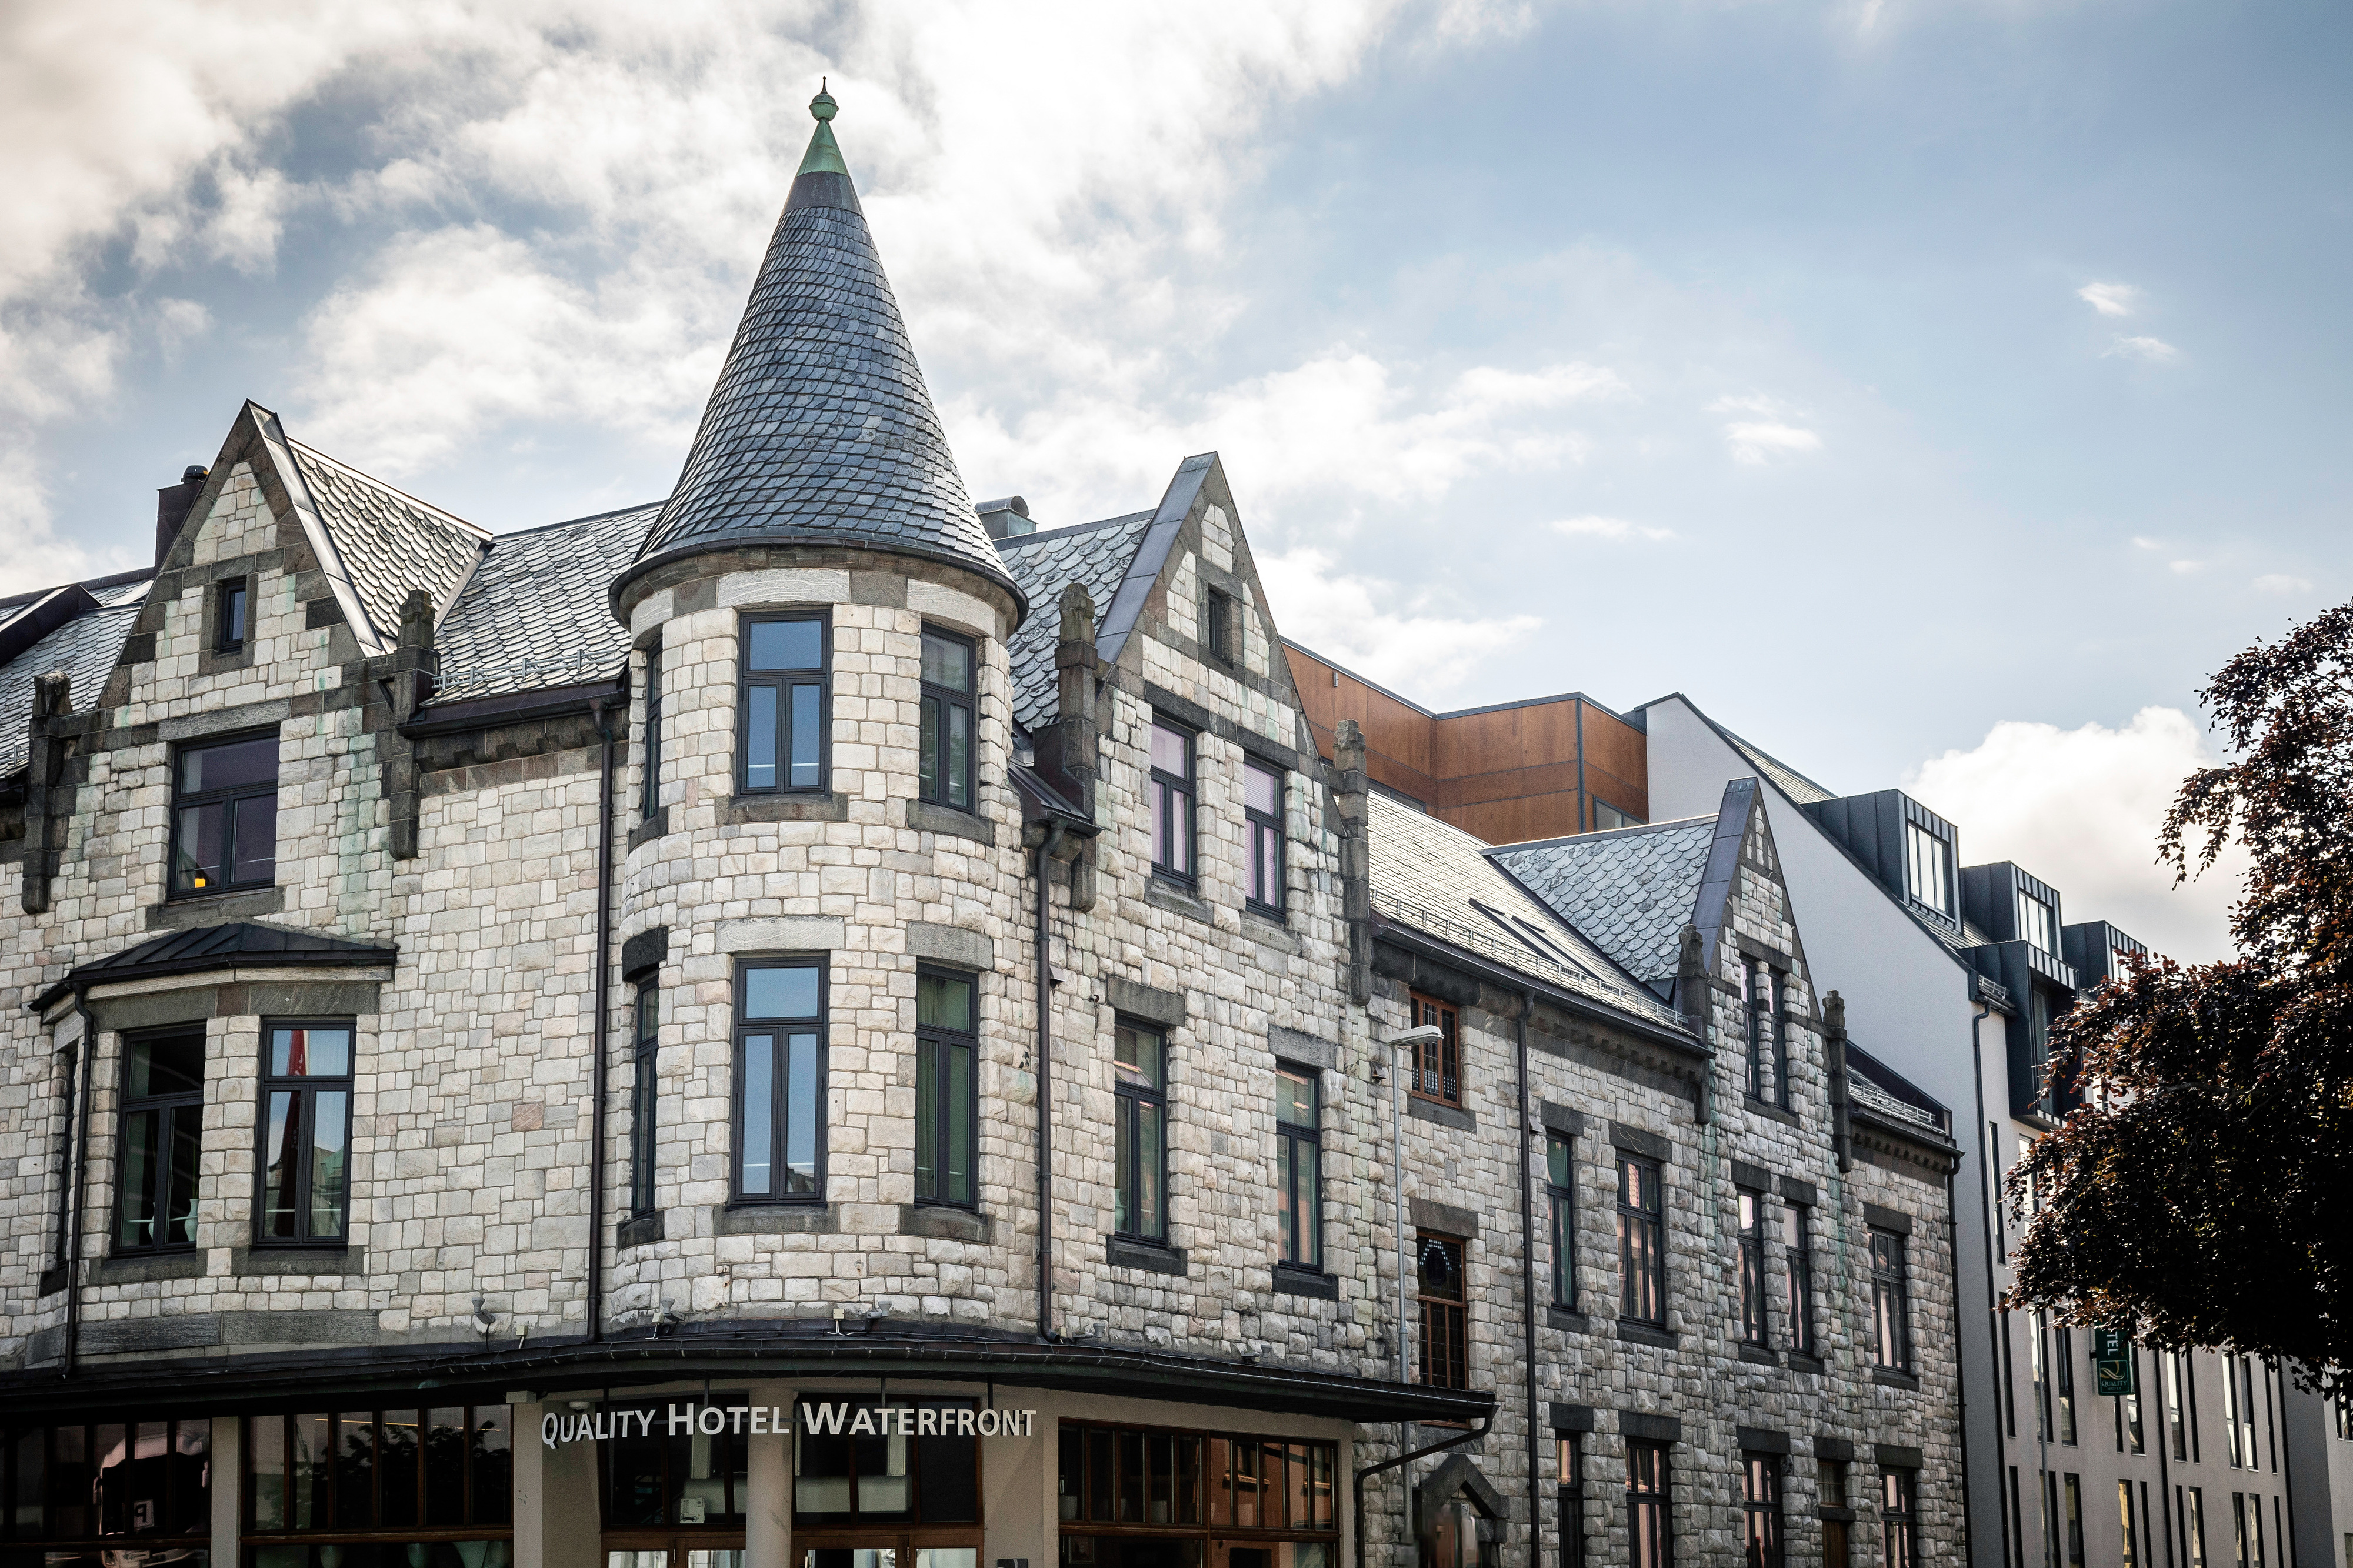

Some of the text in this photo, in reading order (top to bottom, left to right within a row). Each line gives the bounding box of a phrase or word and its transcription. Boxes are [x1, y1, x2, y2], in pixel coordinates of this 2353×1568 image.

[2107, 1327, 2119, 1356] TEL
[541, 1402, 1036, 1449] QUALITY HOTEL WATERFRONT
